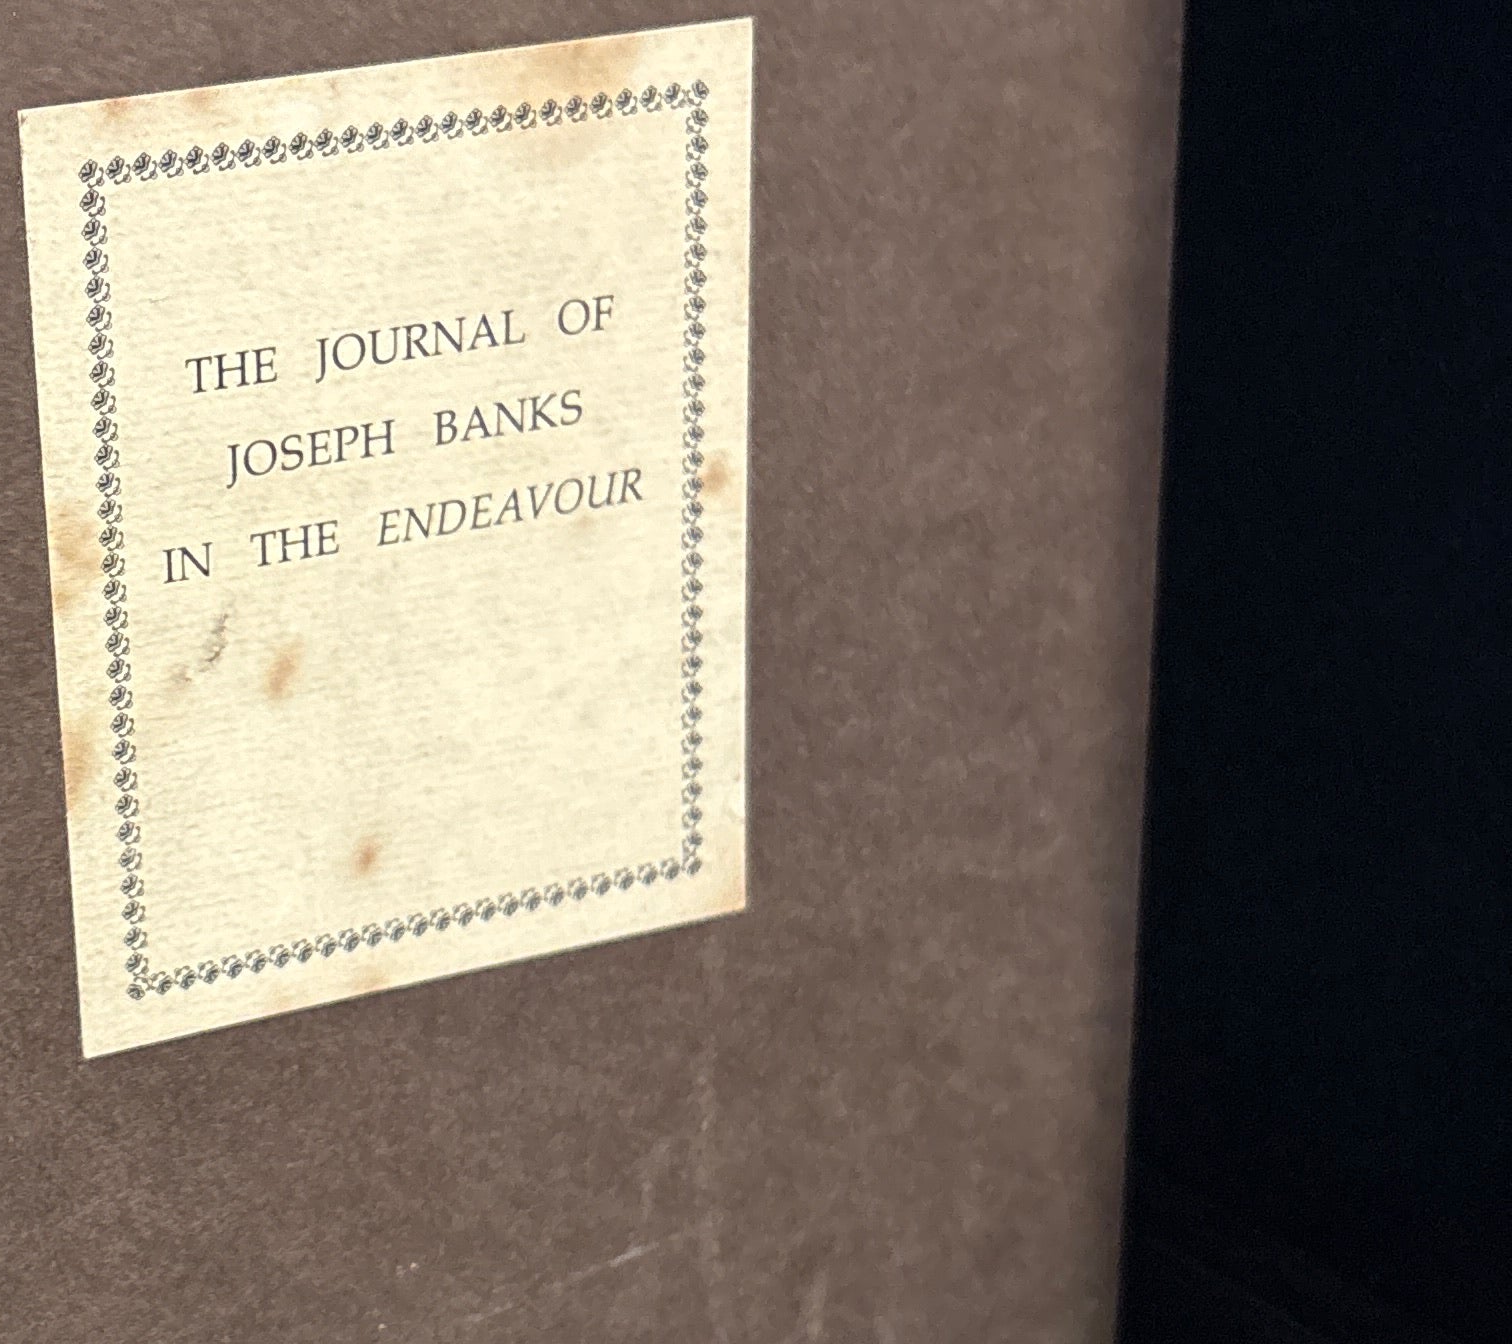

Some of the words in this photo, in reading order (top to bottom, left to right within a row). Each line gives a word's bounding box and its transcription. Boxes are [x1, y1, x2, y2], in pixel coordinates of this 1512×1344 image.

[184, 346, 278, 394] THE
[315, 309, 526, 385] JOURNAL
[557, 294, 615, 336] OF
[226, 418, 395, 490] JOSEPH
[433, 389, 583, 447] BANKS
[162, 541, 213, 585] IN
[249, 519, 340, 568] THE
[377, 467, 643, 547] ENDEAVOUR
